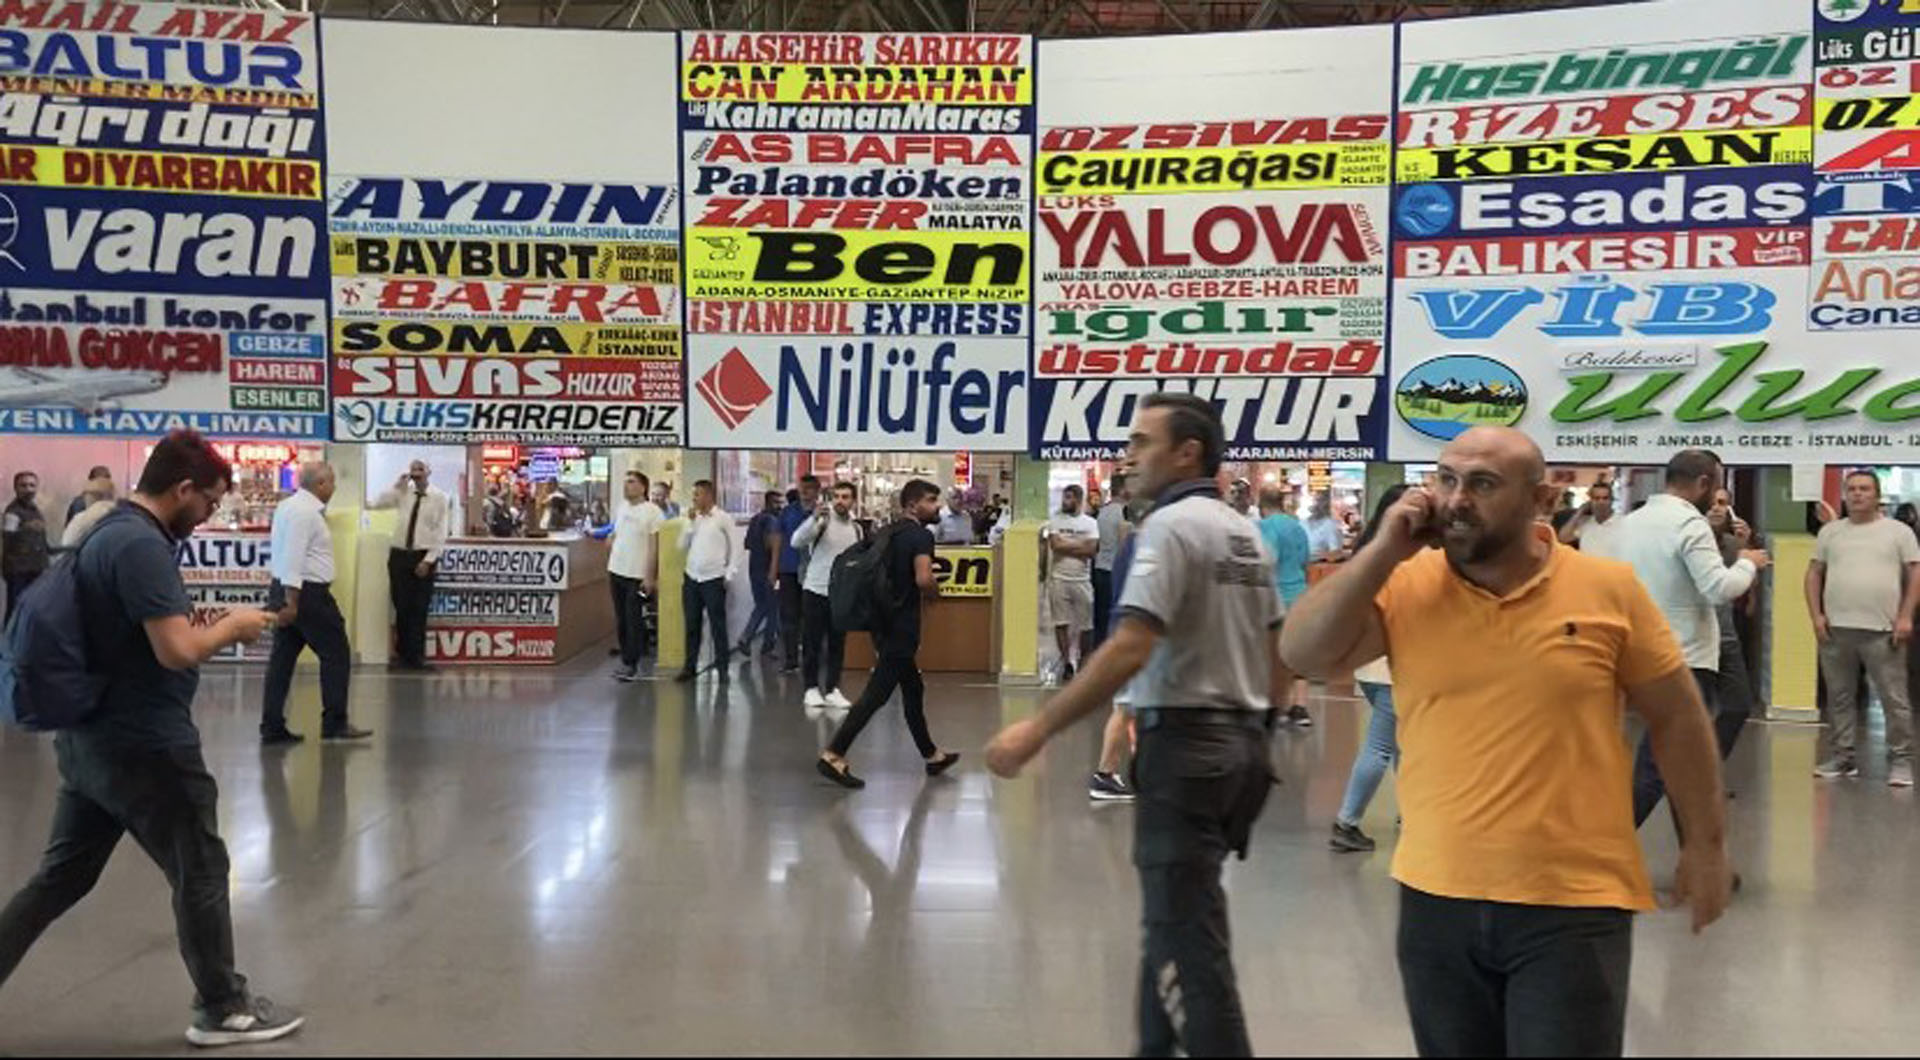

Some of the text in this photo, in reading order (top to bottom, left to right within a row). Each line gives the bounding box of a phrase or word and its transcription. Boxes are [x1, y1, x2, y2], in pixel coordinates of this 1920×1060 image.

[153, 8, 311, 43] AYAZ
[0, 30, 303, 88] BALTUR
[875, 36, 1022, 66] SARIKIZ
[688, 65, 1026, 102] CAN ARDAHAN
[1401, 85, 1807, 148] RİZE SES
[705, 134, 793, 163] AS
[807, 136, 1022, 166] BAFRA
[63, 152, 317, 197] DİYARBAKIR
[693, 166, 1022, 198] Palandöken
[331, 178, 668, 225] AYDIN
[693, 198, 929, 229] ZAFER
[1460, 175, 1808, 230] Esadaş
[928, 216, 1022, 230] MALATYA
[1039, 203, 1369, 268] YALOVA
[44, 207, 317, 279] varan
[357, 239, 599, 280] BAYBURT
[747, 230, 1024, 286] Ben
[1406, 232, 1738, 277] BALIKESİR
[163, 299, 316, 332] konfor
[377, 279, 663, 322] BAFRA
[690, 301, 854, 335] İSTANBUL
[863, 303, 1023, 336] EXPRESS
[237, 335, 312, 352] GEBZE
[341, 322, 573, 354] SOMA
[237, 362, 316, 381] HAREM
[1038, 340, 1383, 376] üstündağ
[351, 356, 563, 397] SİVAS
[567, 373, 636, 396] HUZUR
[777, 342, 1025, 446] Nilüfer
[235, 389, 320, 408] ESENLER
[1657, 434, 1723, 447] ANKARA
[1739, 434, 1792, 447] GEBZE
[1808, 432, 1892, 446] İSTANBUL
[931, 557, 990, 585] en
[425, 630, 515, 657] İVAS
